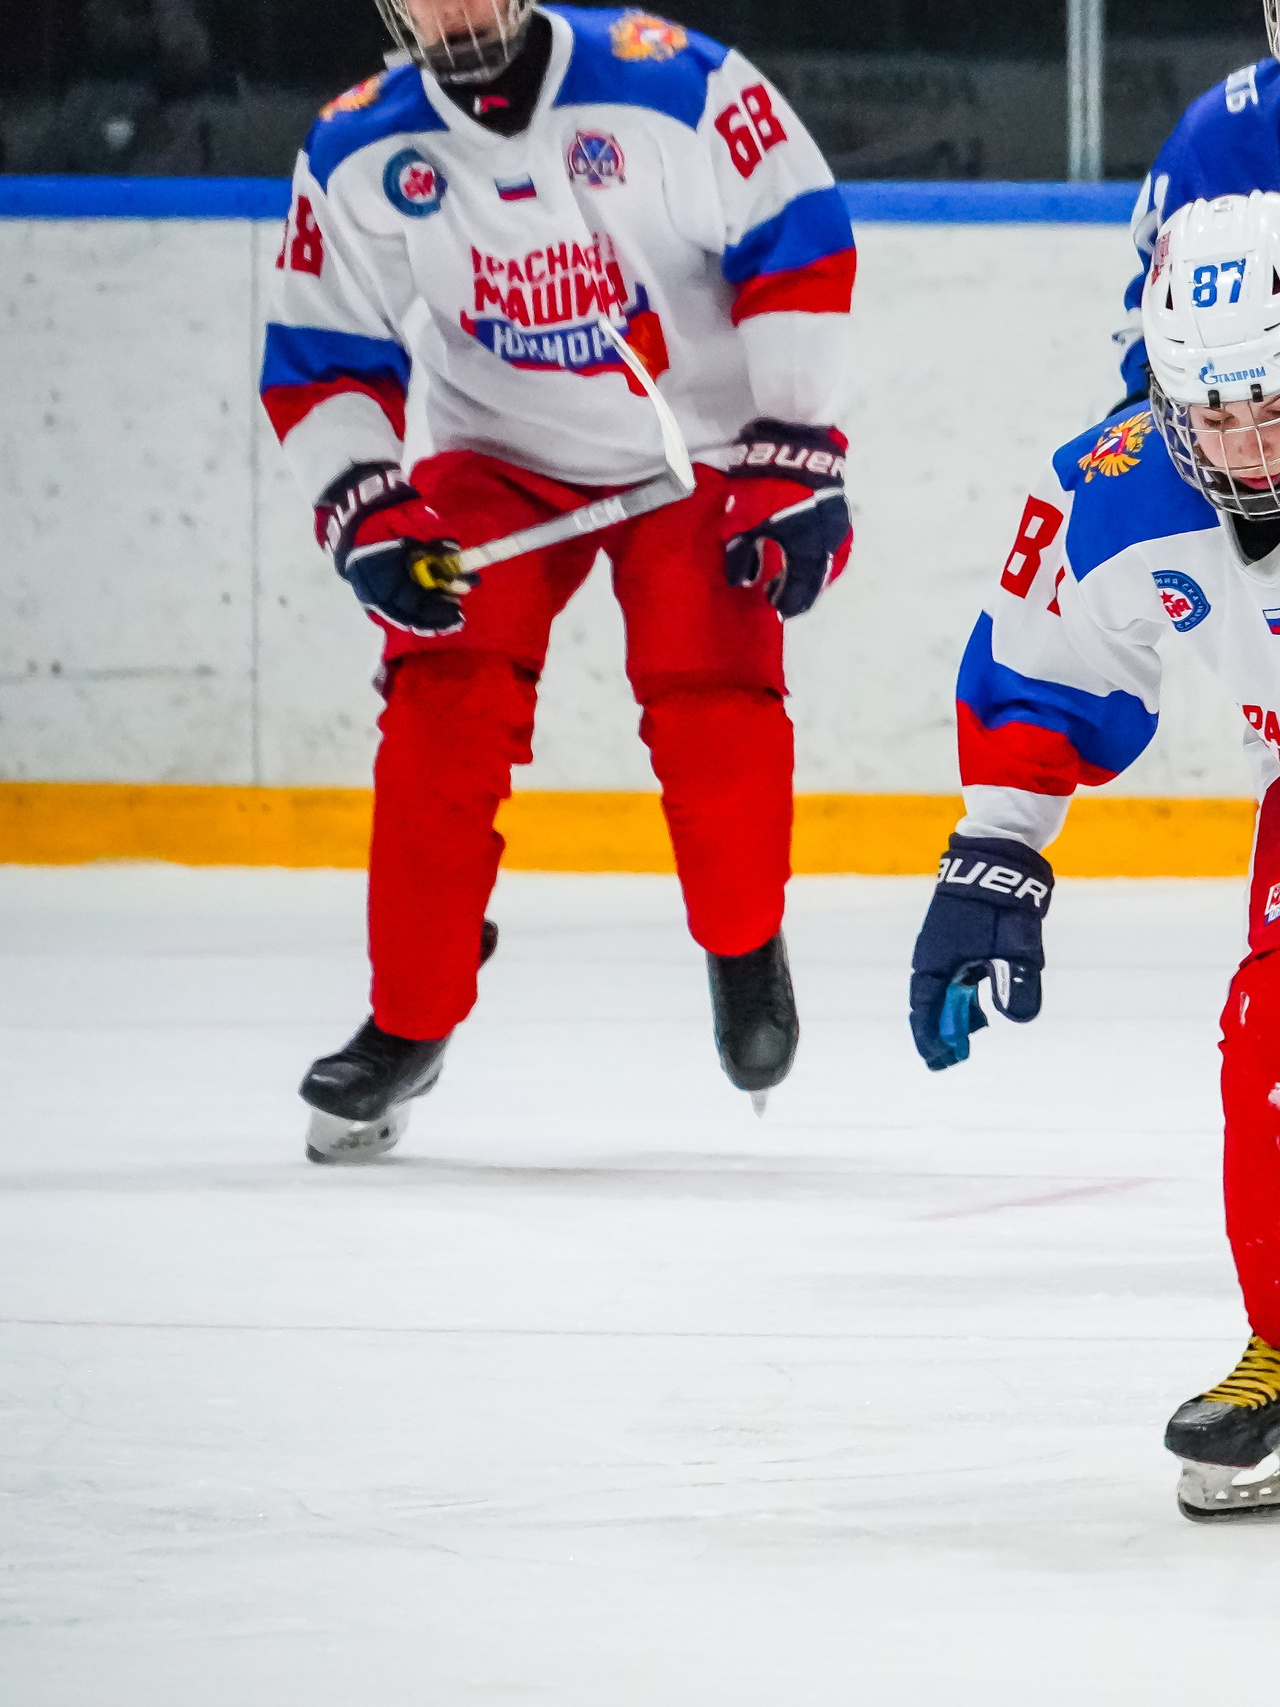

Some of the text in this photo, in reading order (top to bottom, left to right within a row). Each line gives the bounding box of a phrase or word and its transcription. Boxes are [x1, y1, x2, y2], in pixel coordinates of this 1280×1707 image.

[714, 83, 788, 178] 68
[276, 194, 324, 278] 8
[1193, 258, 1246, 308] 87
